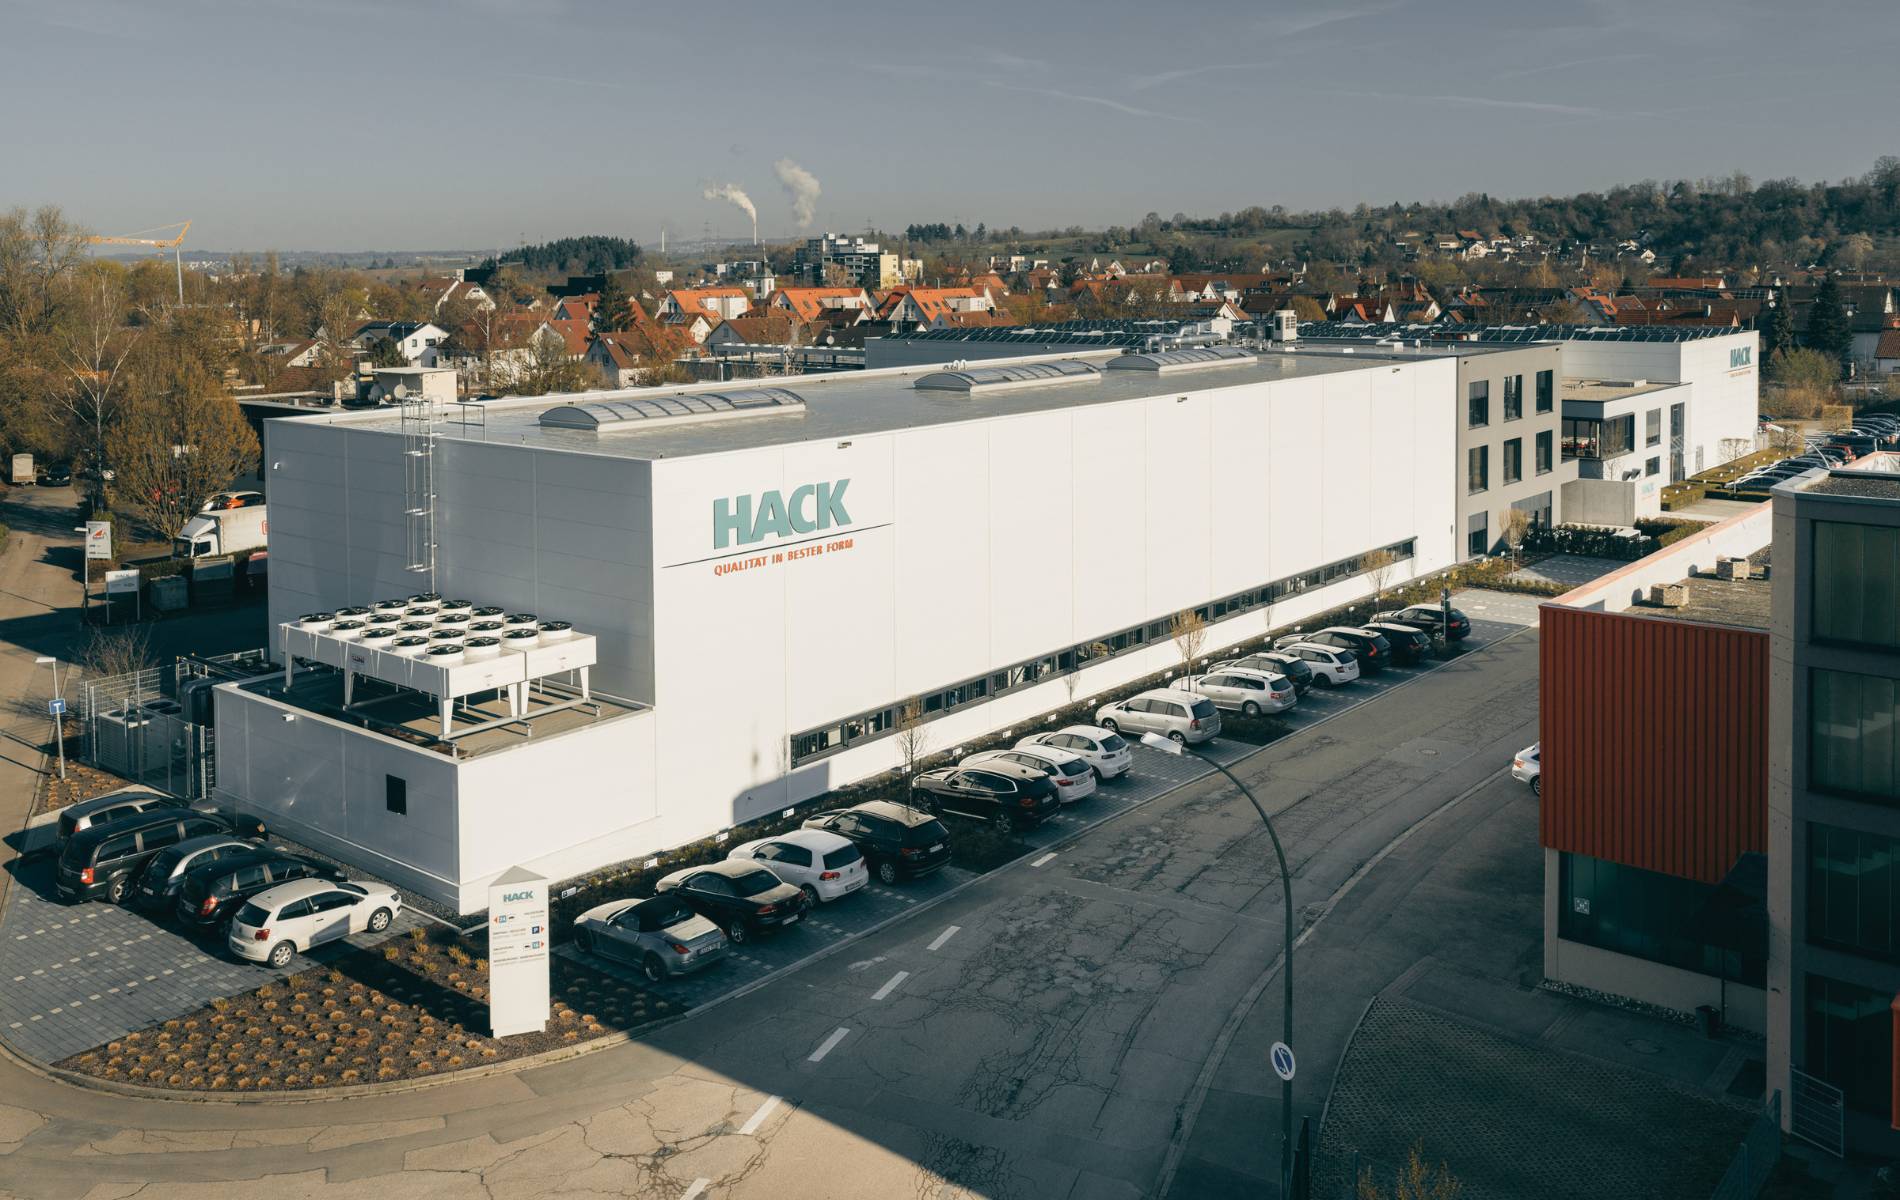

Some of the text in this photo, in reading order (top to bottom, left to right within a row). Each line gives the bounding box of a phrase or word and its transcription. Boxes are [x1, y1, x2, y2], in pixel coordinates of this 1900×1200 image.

[713, 478, 853, 550] HACK
[771, 553, 783, 564] IN
[788, 545, 823, 561] BESTER
[826, 539, 853, 553] FORM
[503, 891, 533, 902] HACK
